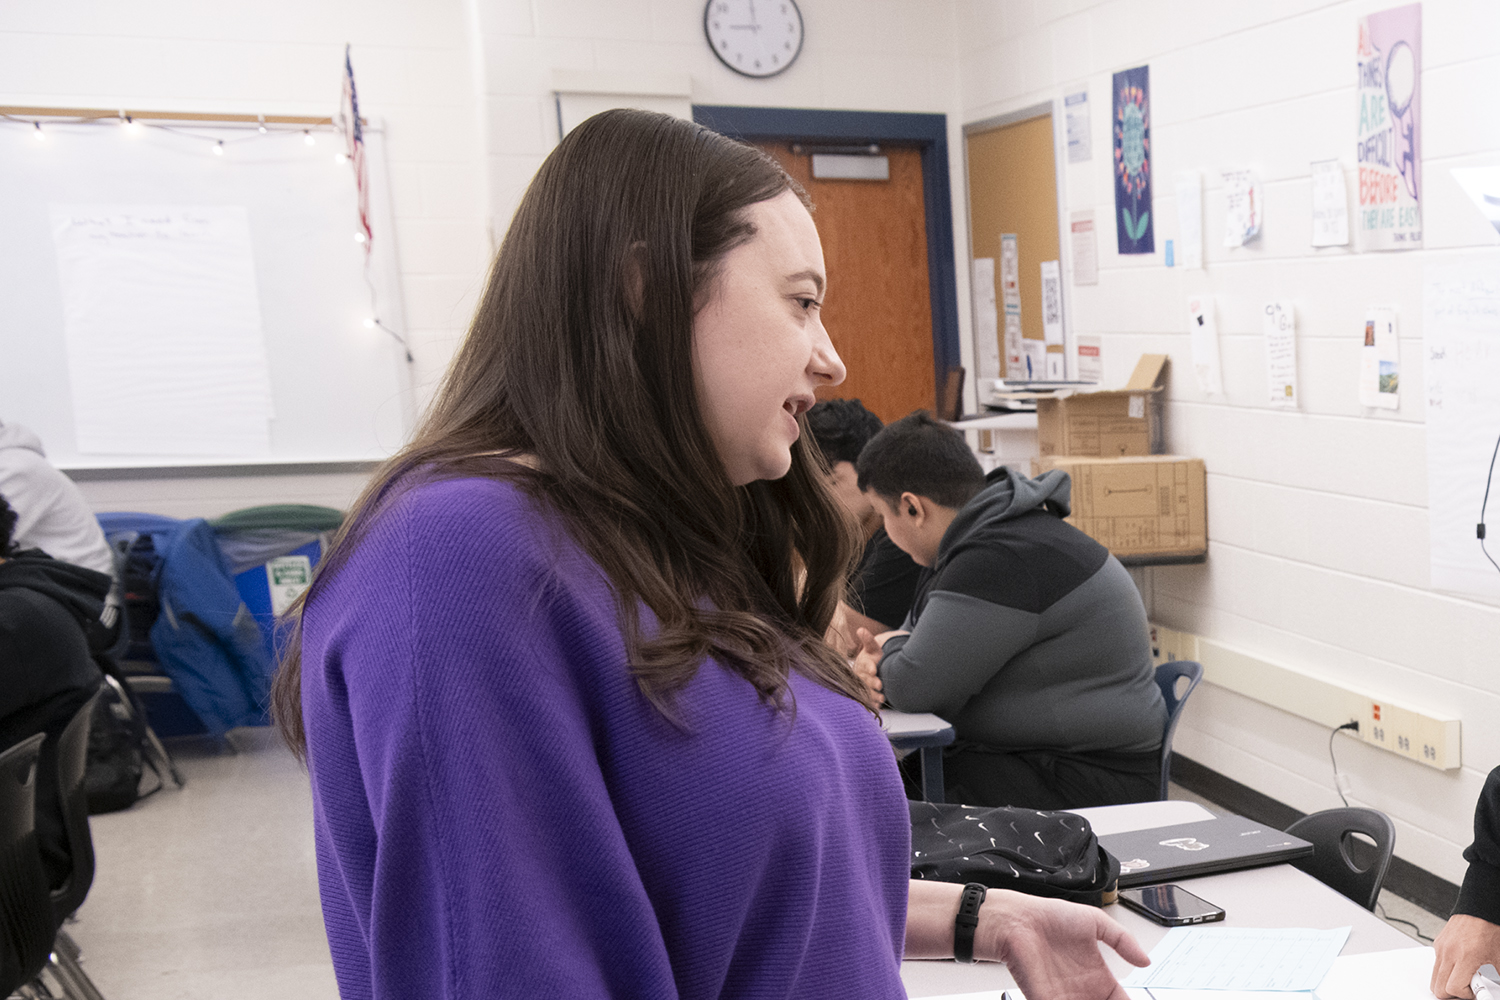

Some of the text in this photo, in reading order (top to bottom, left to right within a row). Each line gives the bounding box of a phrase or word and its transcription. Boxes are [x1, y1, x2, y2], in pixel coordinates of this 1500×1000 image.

[1358, 92, 1386, 137] ARE
[1359, 167, 1399, 206] BEFORE
[1380, 208, 1395, 229] ARE
[1398, 206, 1420, 228] EASY
